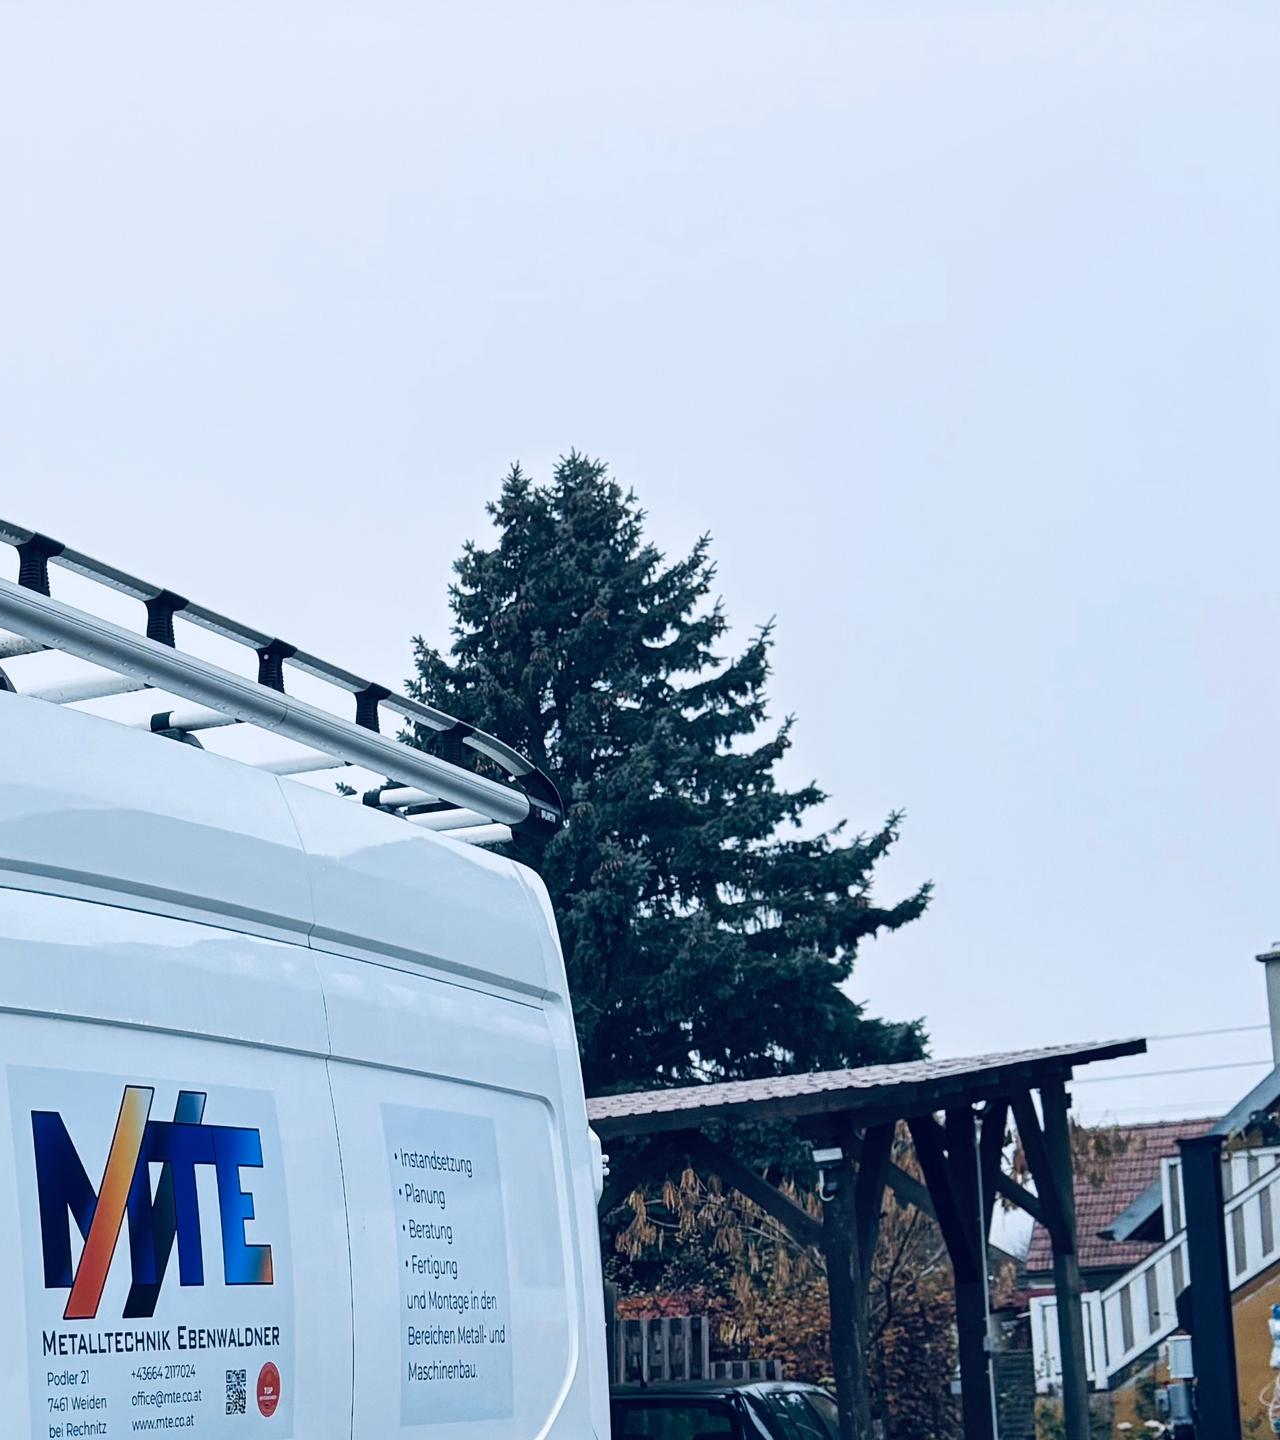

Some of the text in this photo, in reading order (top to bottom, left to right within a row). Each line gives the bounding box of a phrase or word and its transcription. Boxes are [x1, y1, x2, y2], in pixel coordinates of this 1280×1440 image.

[400, 1147, 473, 1178] Instandsetzung
[404, 1182, 446, 1210] Planung
[408, 1218, 453, 1245] Beratung
[411, 1254, 458, 1280] Fertigung
[406, 1289, 498, 1314] und Montage in den
[42, 1325, 280, 1356] METALLTECHNIK EBENWALDNER
[407, 1323, 506, 1346] Bereichen Metall- und
[47, 1369, 90, 1386] Podler 21
[131, 1366, 163, 1381] +43664
[408, 1358, 478, 1382] Maschinenbau.
[47, 1394, 108, 1412] 7461 Weiden
[131, 1389, 202, 1408] office@mte.co.at
[48, 1419, 108, 1439] bei Rechnitz
[131, 1414, 195, 1431] www.mte.co.at
